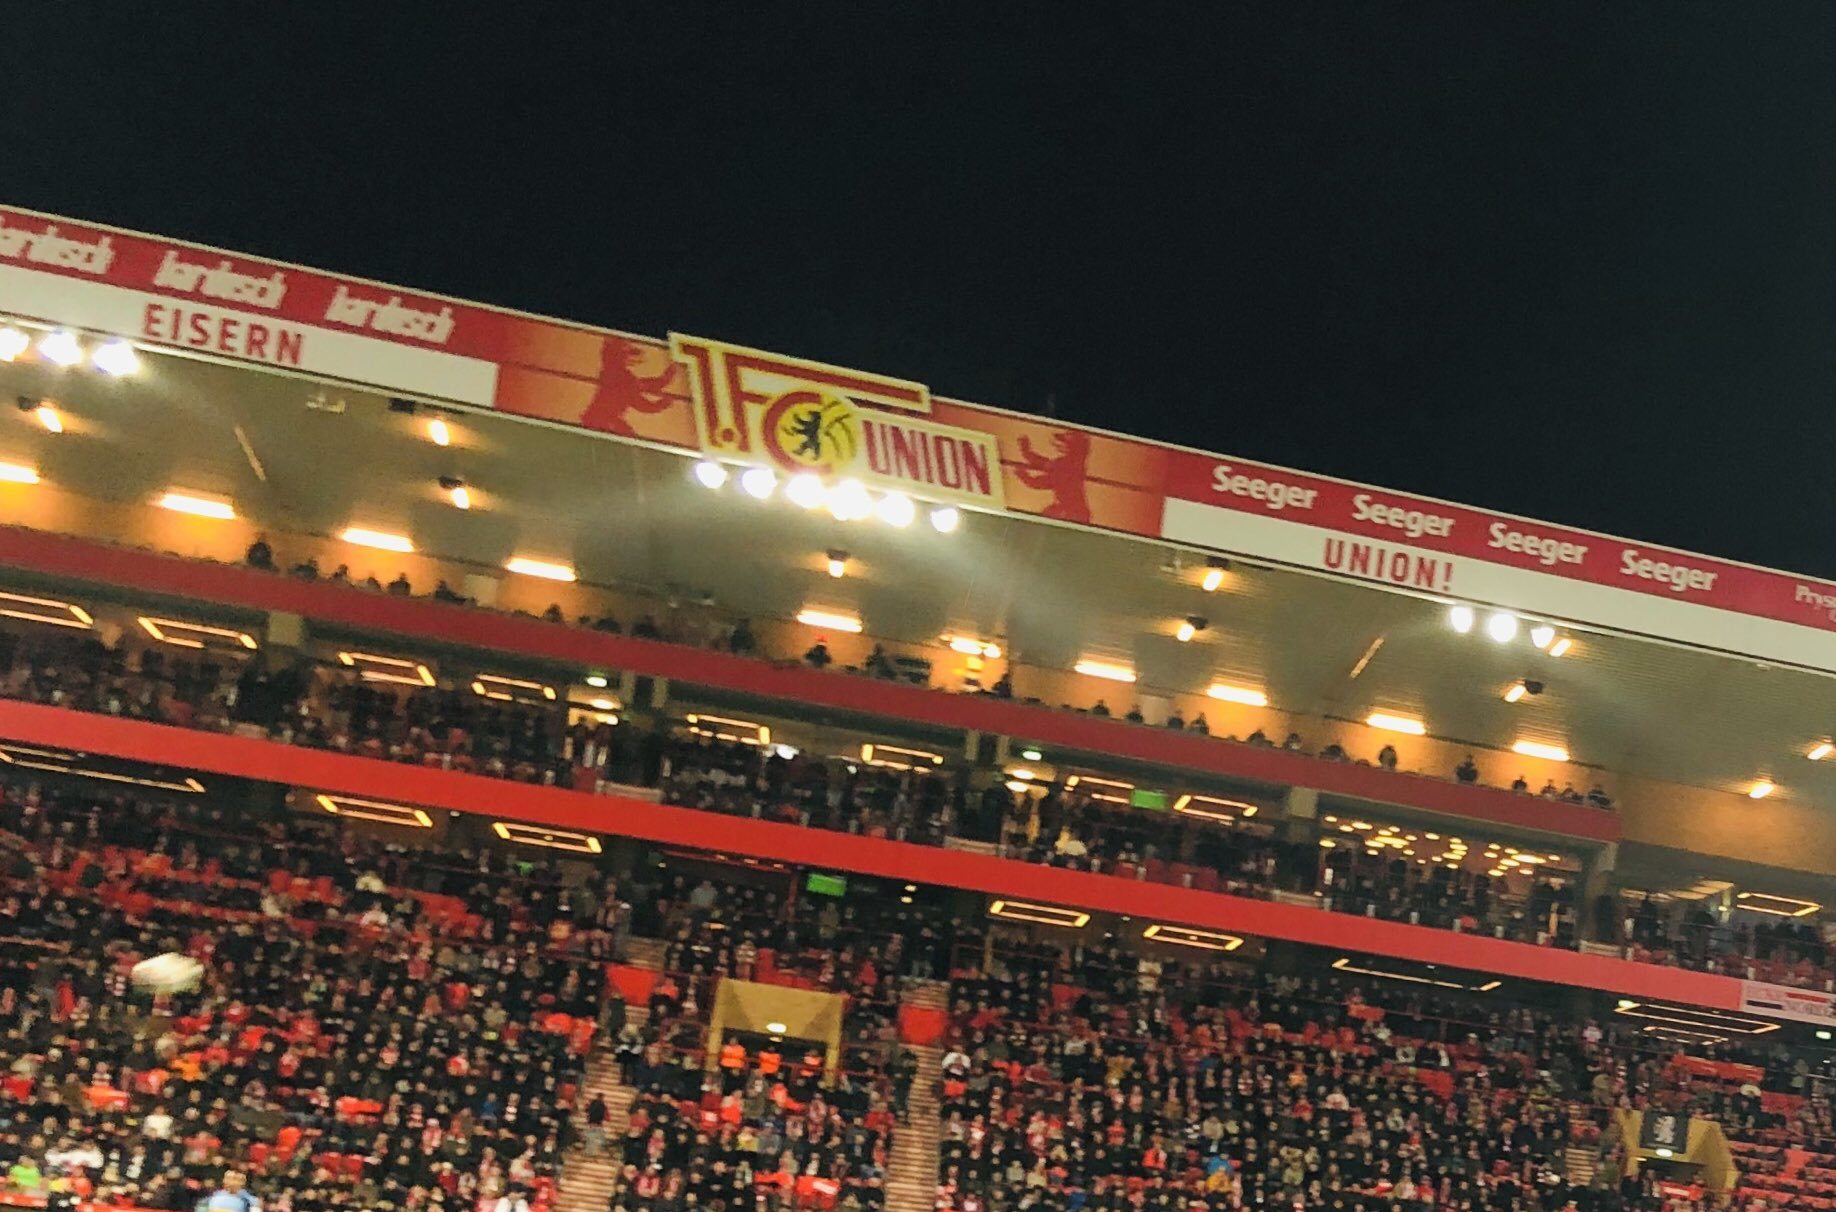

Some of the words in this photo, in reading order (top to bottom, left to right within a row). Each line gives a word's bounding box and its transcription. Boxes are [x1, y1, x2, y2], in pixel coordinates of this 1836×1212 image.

[143, 303, 304, 364] EISERN
[863, 419, 991, 496] UNION
[1212, 465, 1317, 510] Seeger
[1351, 494, 1455, 538] Seeger
[1322, 537, 1454, 592] UNION!
[1487, 522, 1588, 566] Seeger
[1620, 548, 1718, 592] Seeger
